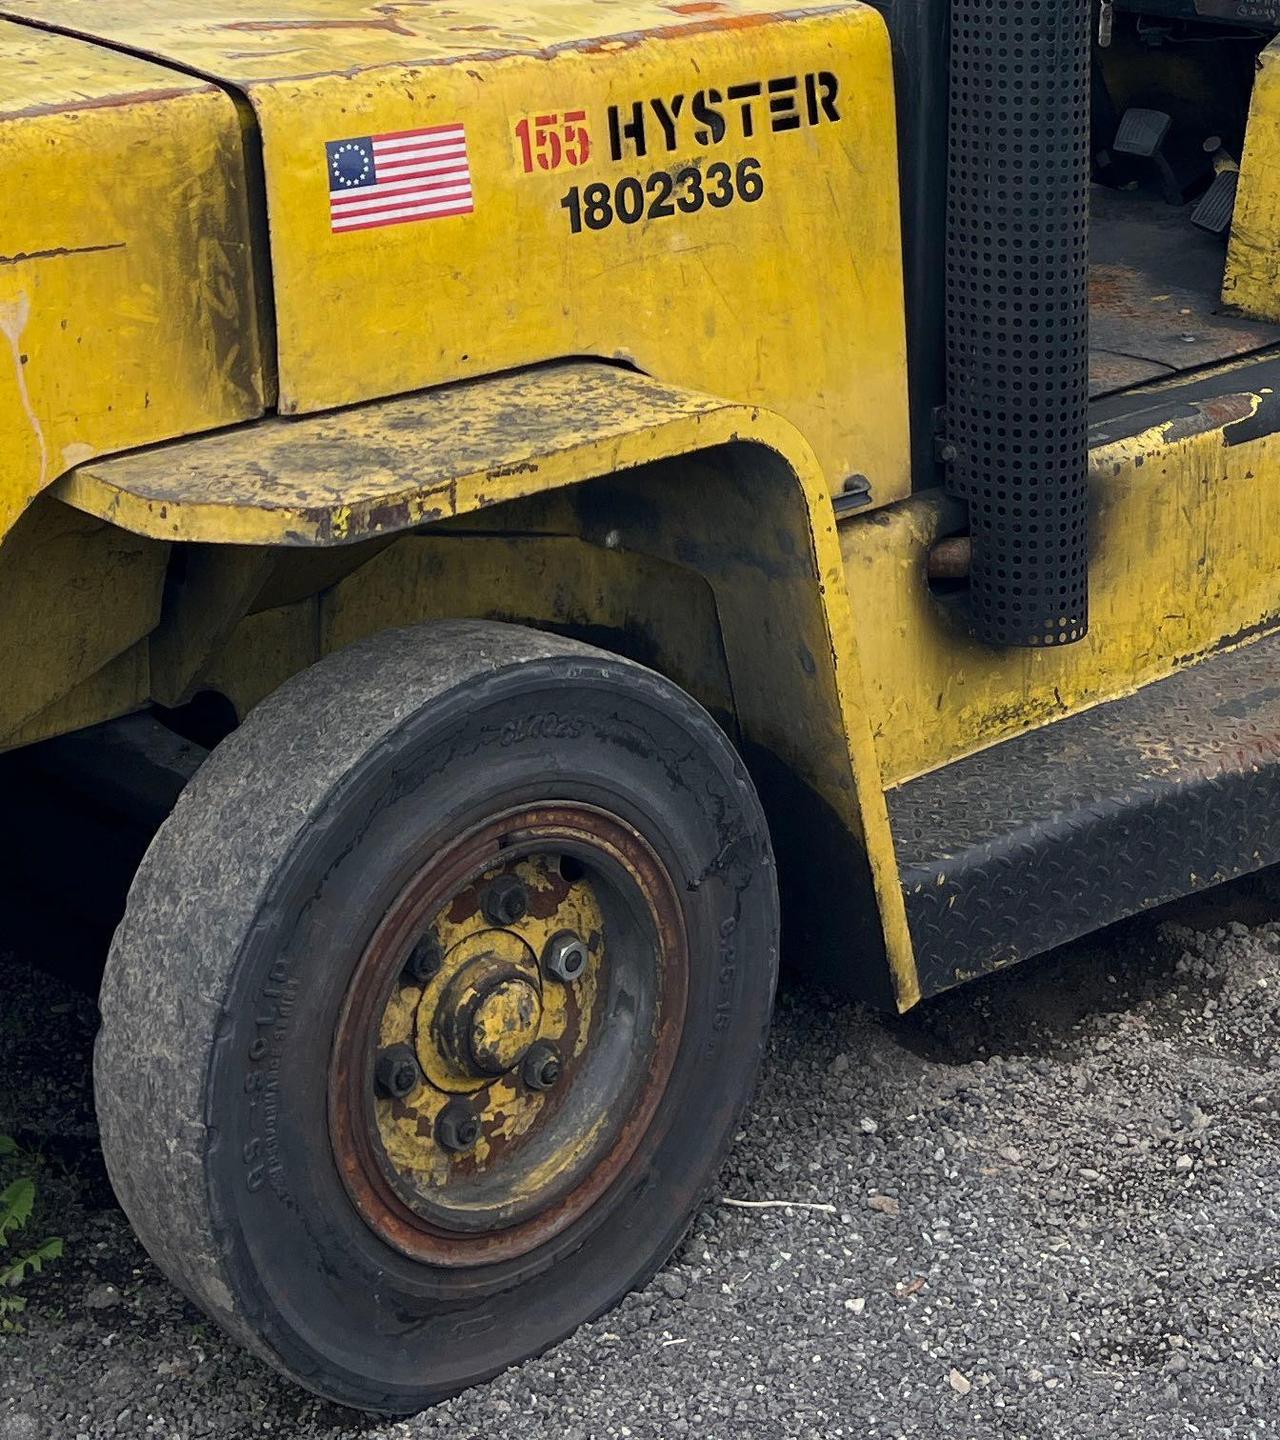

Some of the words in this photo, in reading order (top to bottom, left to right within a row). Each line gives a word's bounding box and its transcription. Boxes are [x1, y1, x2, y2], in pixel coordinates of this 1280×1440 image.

[514, 110, 591, 173] 155
[607, 71, 841, 161] HYSTER
[560, 158, 764, 234] 1802336
